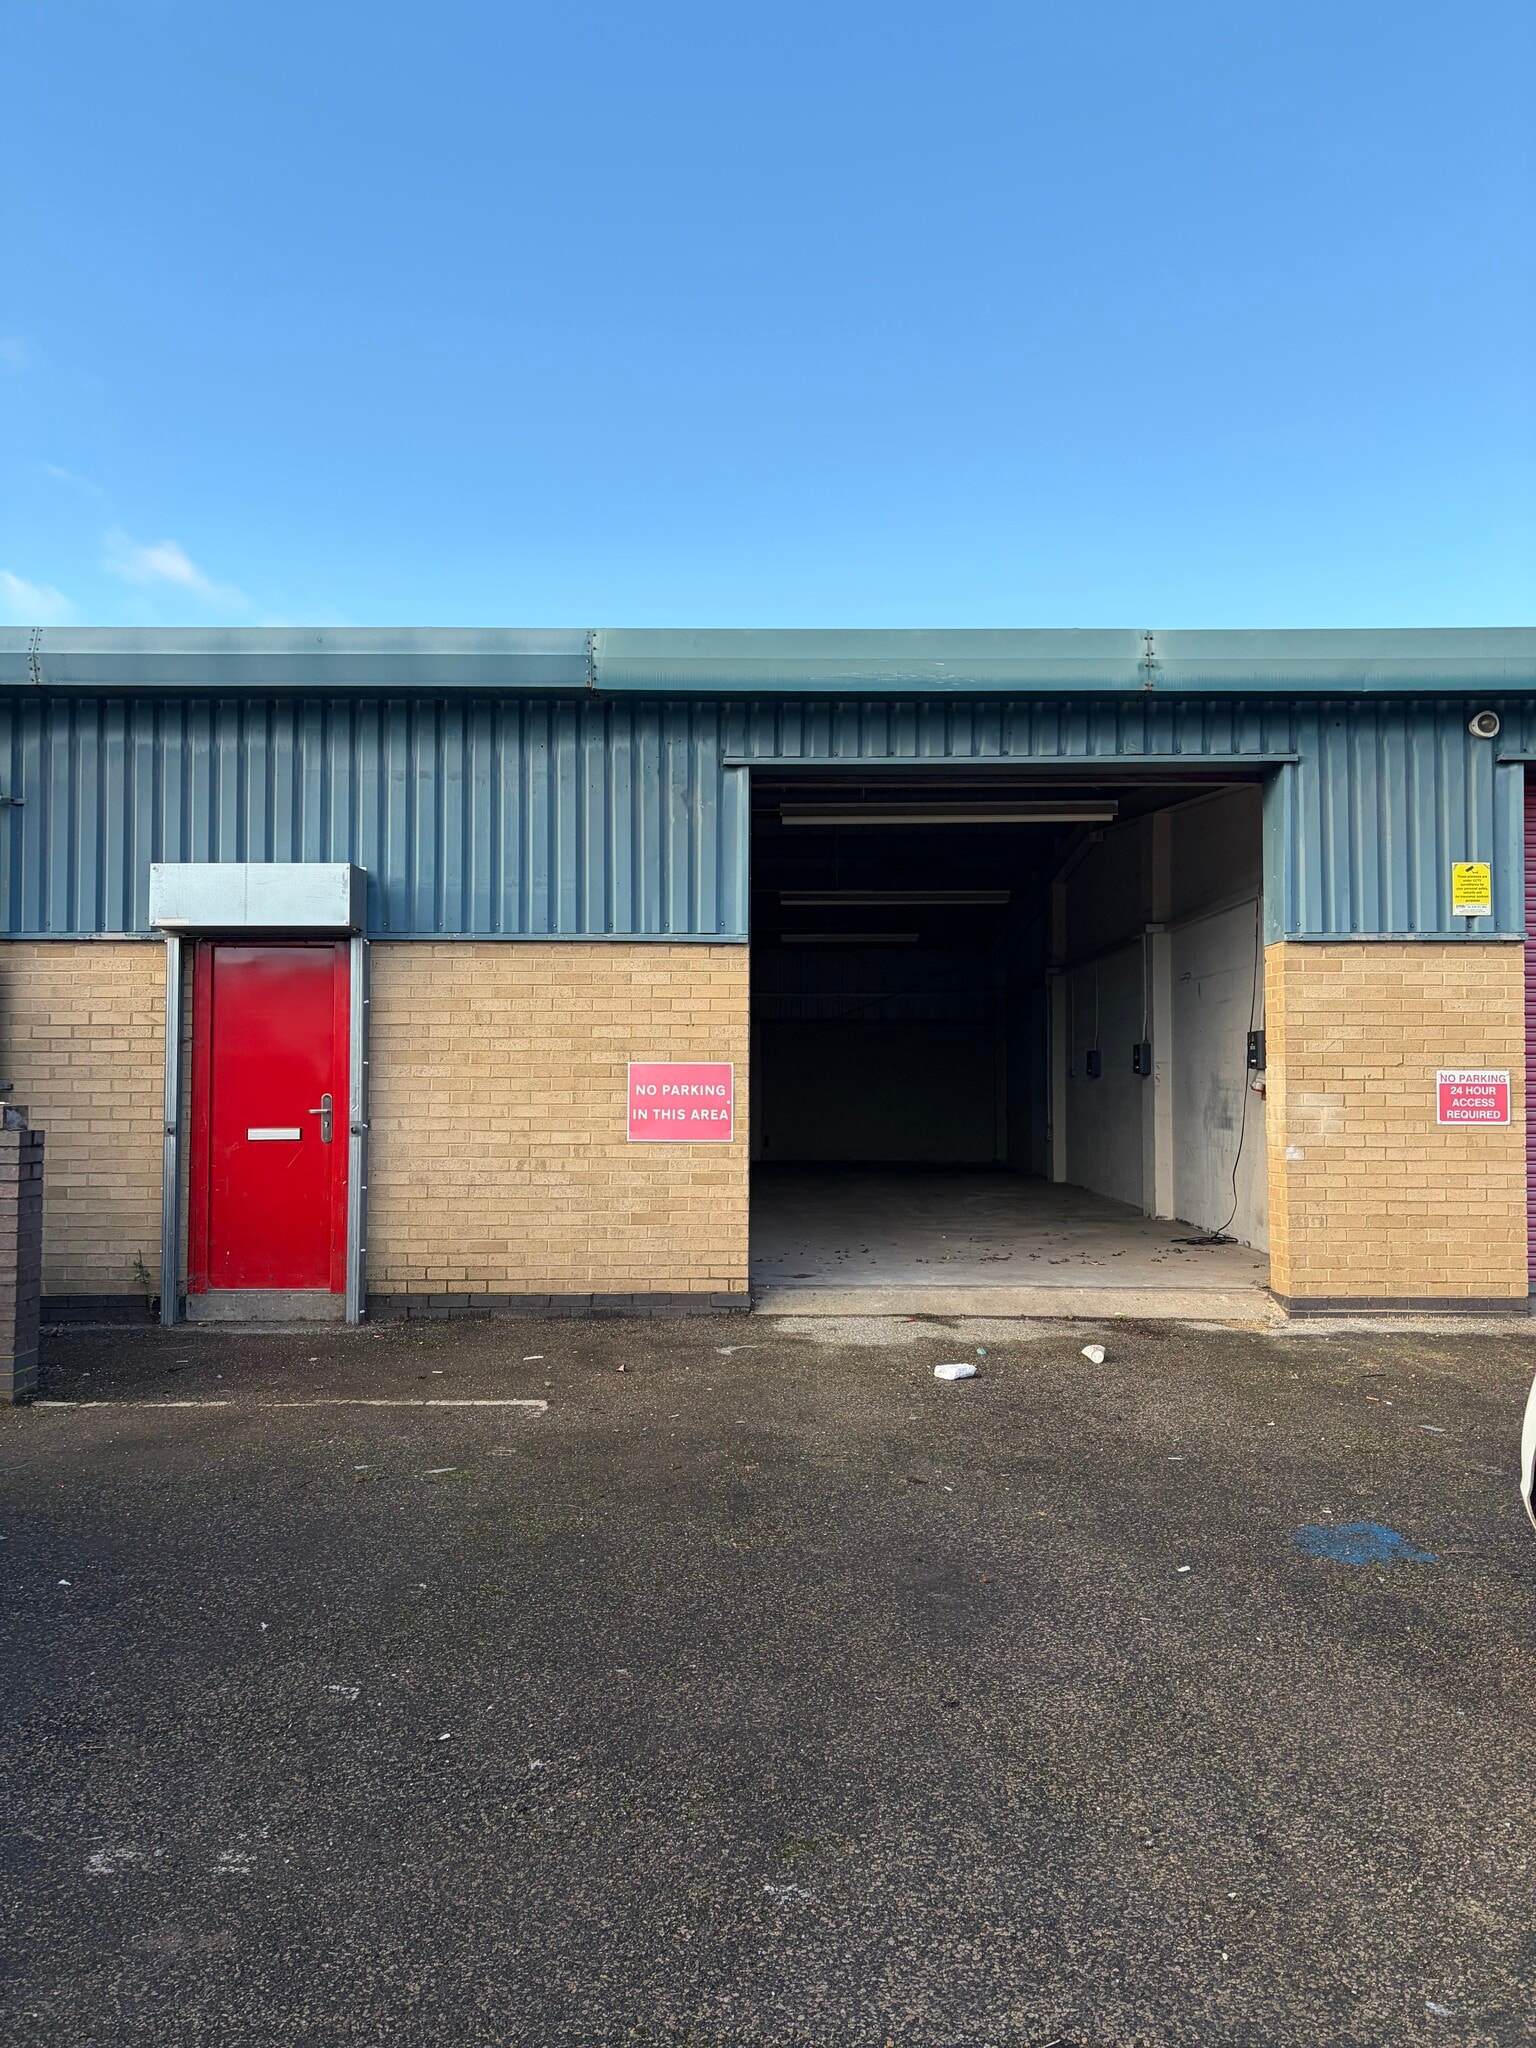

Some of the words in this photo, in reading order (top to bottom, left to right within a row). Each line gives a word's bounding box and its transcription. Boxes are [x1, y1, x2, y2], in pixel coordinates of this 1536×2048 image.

[1440, 1074, 1456, 1083] NO
[1459, 1074, 1506, 1083] PARKING
[636, 1084, 657, 1096] NO
[662, 1084, 726, 1096] PARKING
[1450, 1086, 1463, 1095] 24
[1465, 1086, 1496, 1095] HOUR
[1452, 1098, 1495, 1107] ACCESS
[633, 1108, 648, 1120] IN
[653, 1108, 686, 1120] THIS
[691, 1108, 729, 1120] AREA
[1446, 1110, 1501, 1119] REQUIRED
